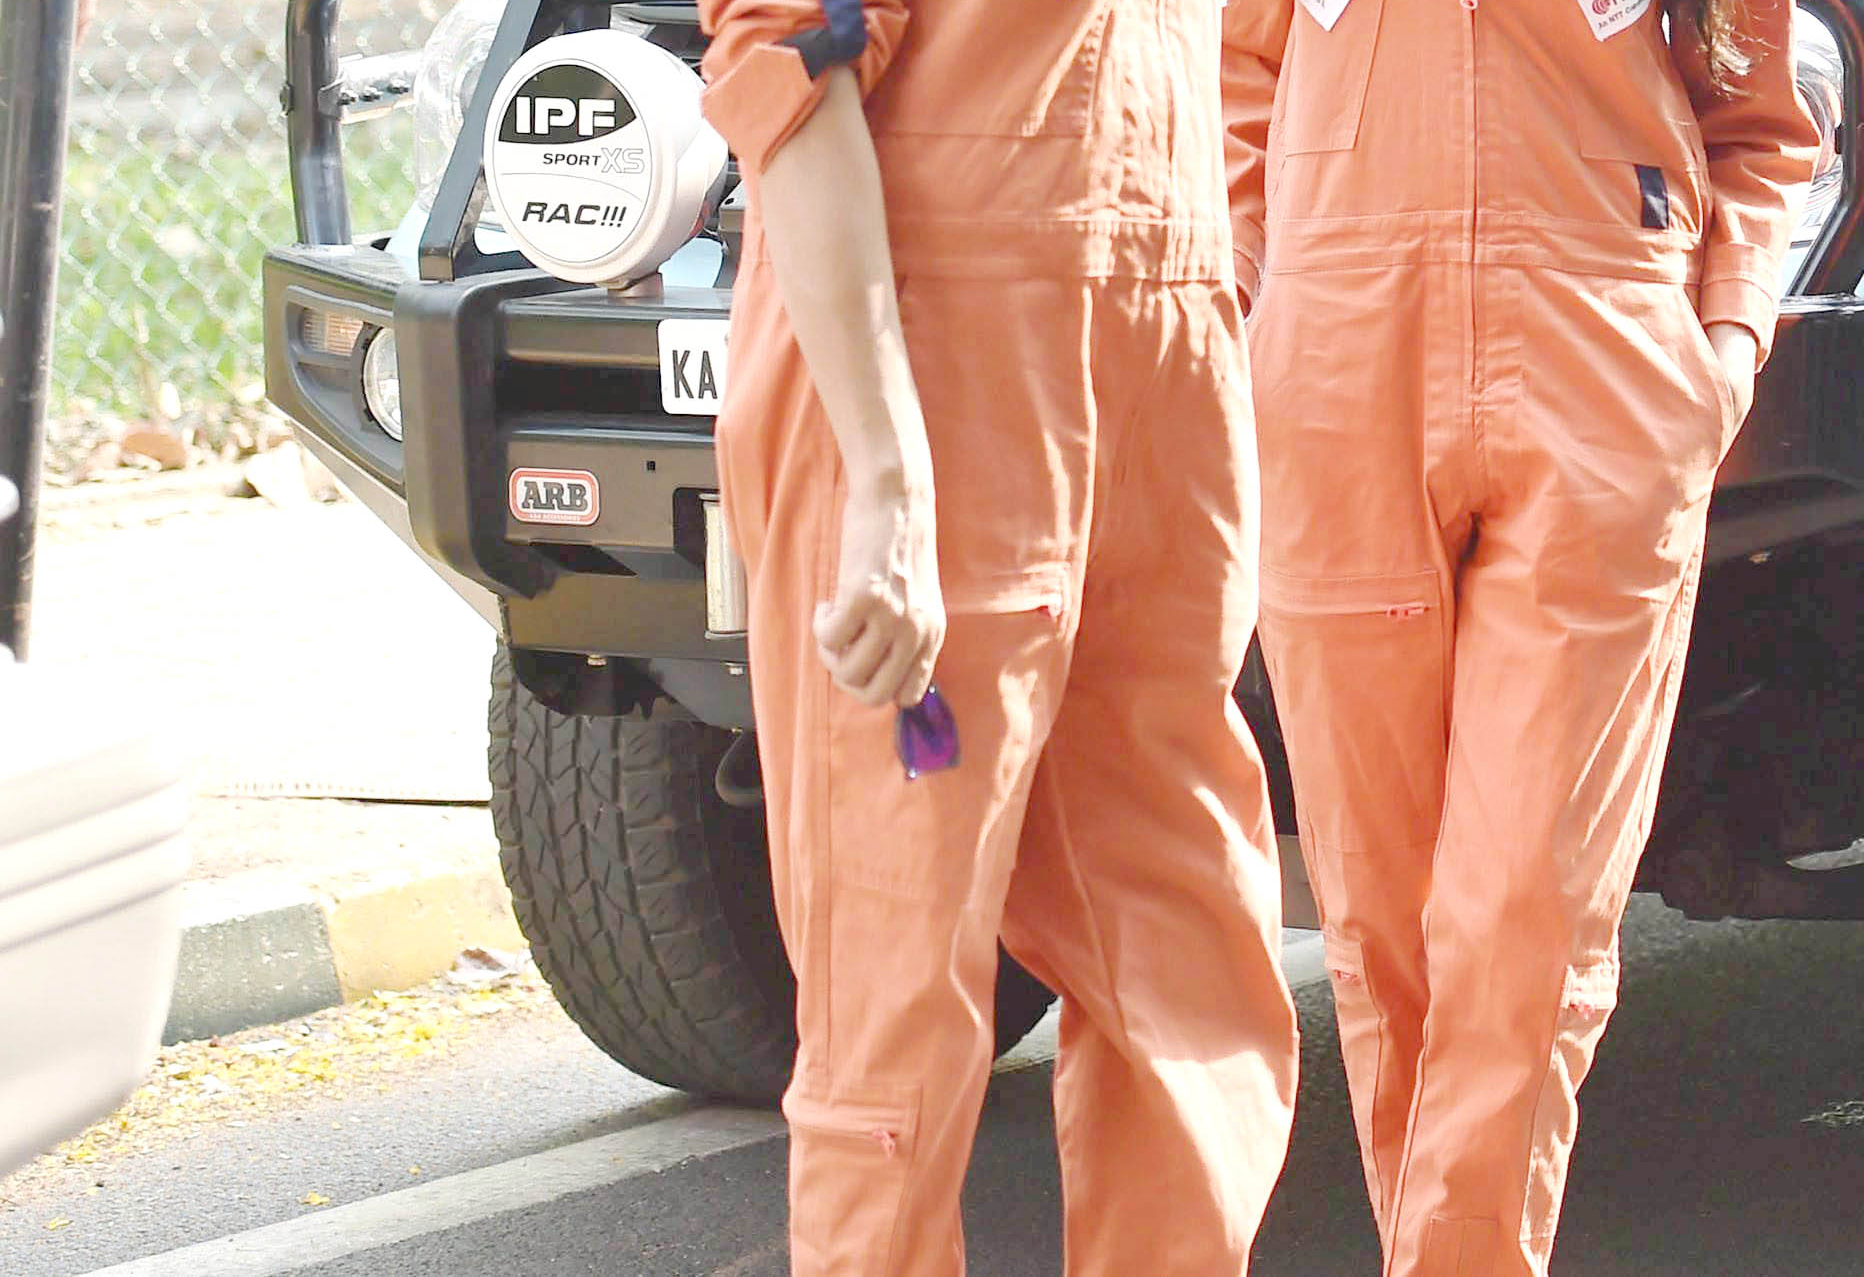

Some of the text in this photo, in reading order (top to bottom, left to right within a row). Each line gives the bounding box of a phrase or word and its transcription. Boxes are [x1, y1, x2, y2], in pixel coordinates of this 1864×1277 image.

[515, 95, 616, 137] IPF
[542, 147, 646, 174] SPORT XS
[521, 201, 628, 228] RAC!!!
[671, 349, 718, 400] KA
[521, 480, 589, 512] ARB
